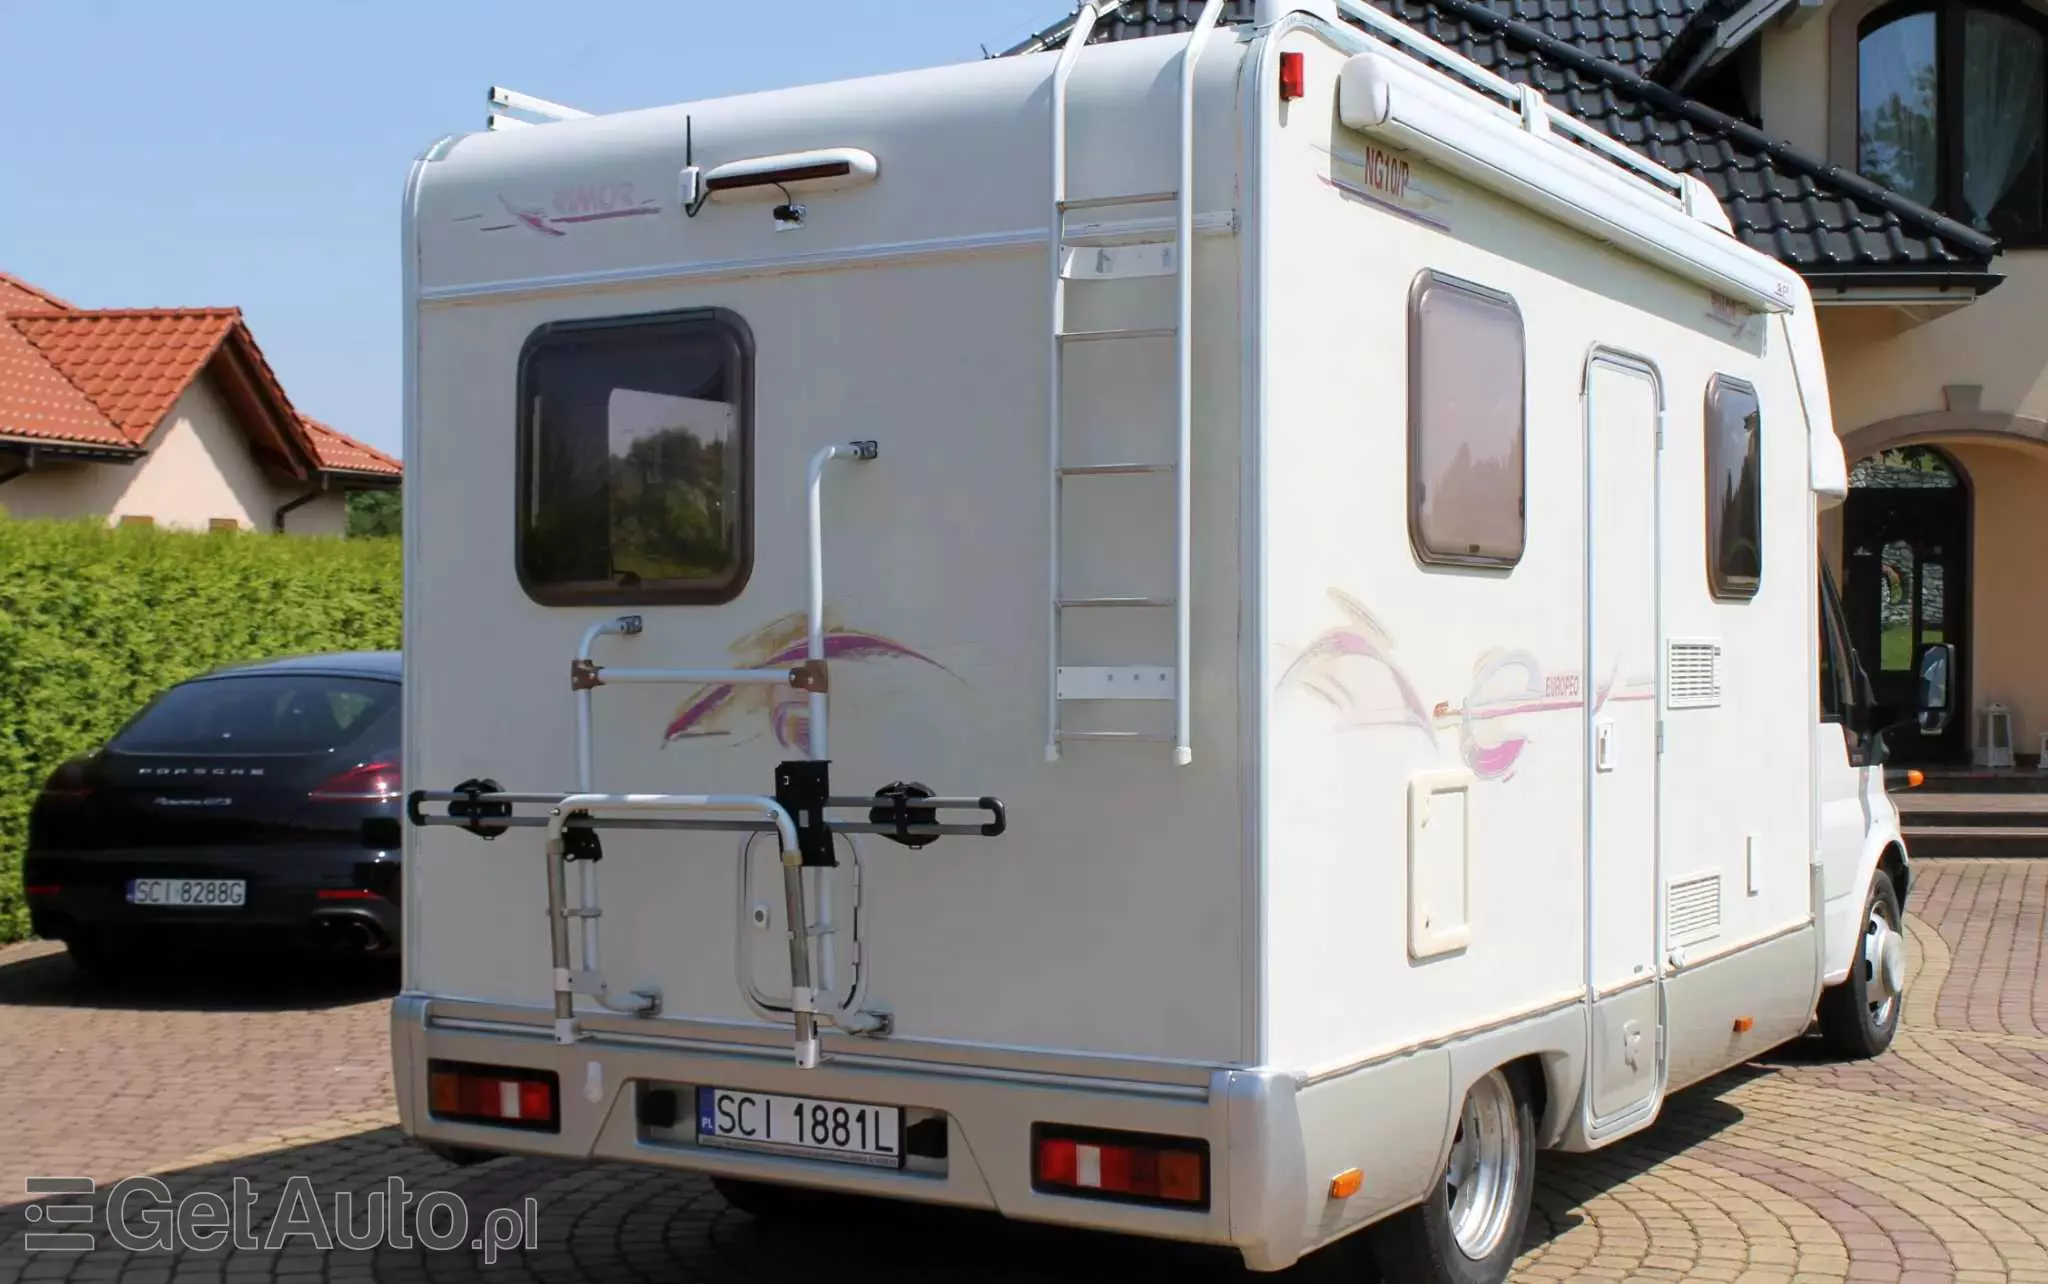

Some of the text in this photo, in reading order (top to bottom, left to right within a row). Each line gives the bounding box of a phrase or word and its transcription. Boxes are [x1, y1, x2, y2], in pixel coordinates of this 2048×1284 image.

[138, 881, 243, 903] SCI 8288G
[701, 1117, 713, 1129] PL
[717, 1094, 771, 1139] SCI
[793, 1102, 894, 1153] 1881L
